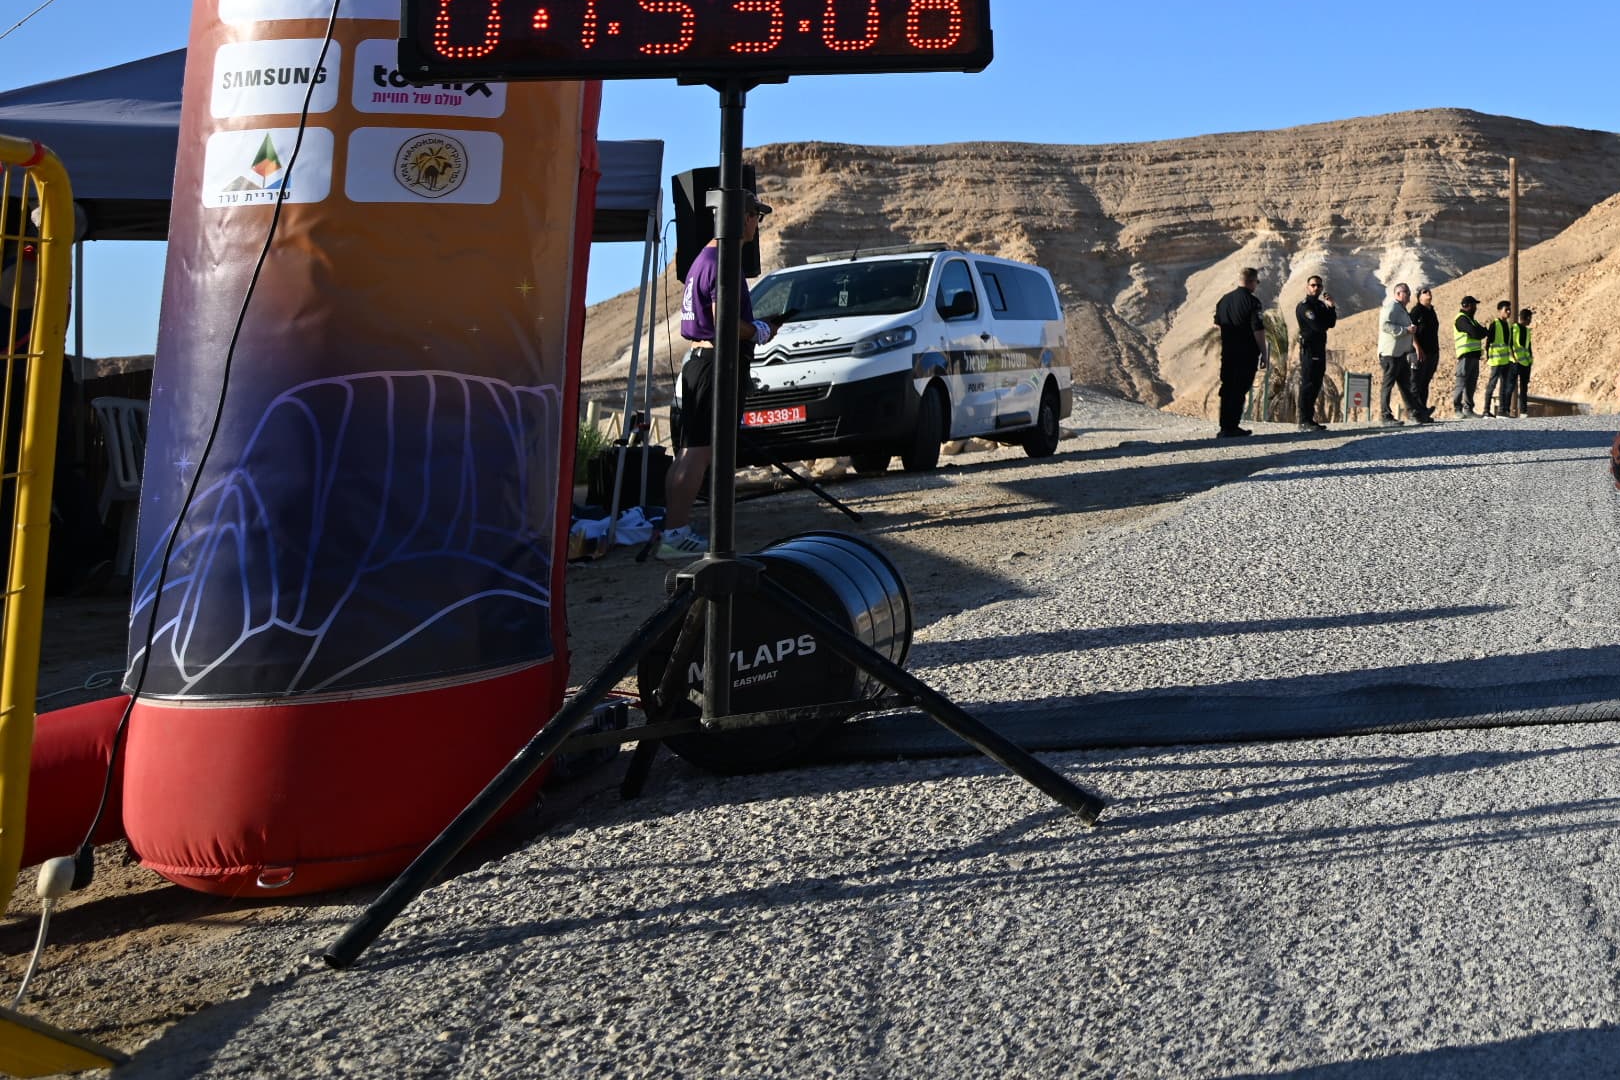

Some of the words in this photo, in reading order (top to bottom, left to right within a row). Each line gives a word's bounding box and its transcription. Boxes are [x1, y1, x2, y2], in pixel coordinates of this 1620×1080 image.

[222, 66, 328, 90] SAMSUNG
[412, 91, 432, 105] של
[434, 92, 463, 107] עולם
[688, 633, 817, 684] MLAPS
[733, 669, 779, 688] EASYMAT
